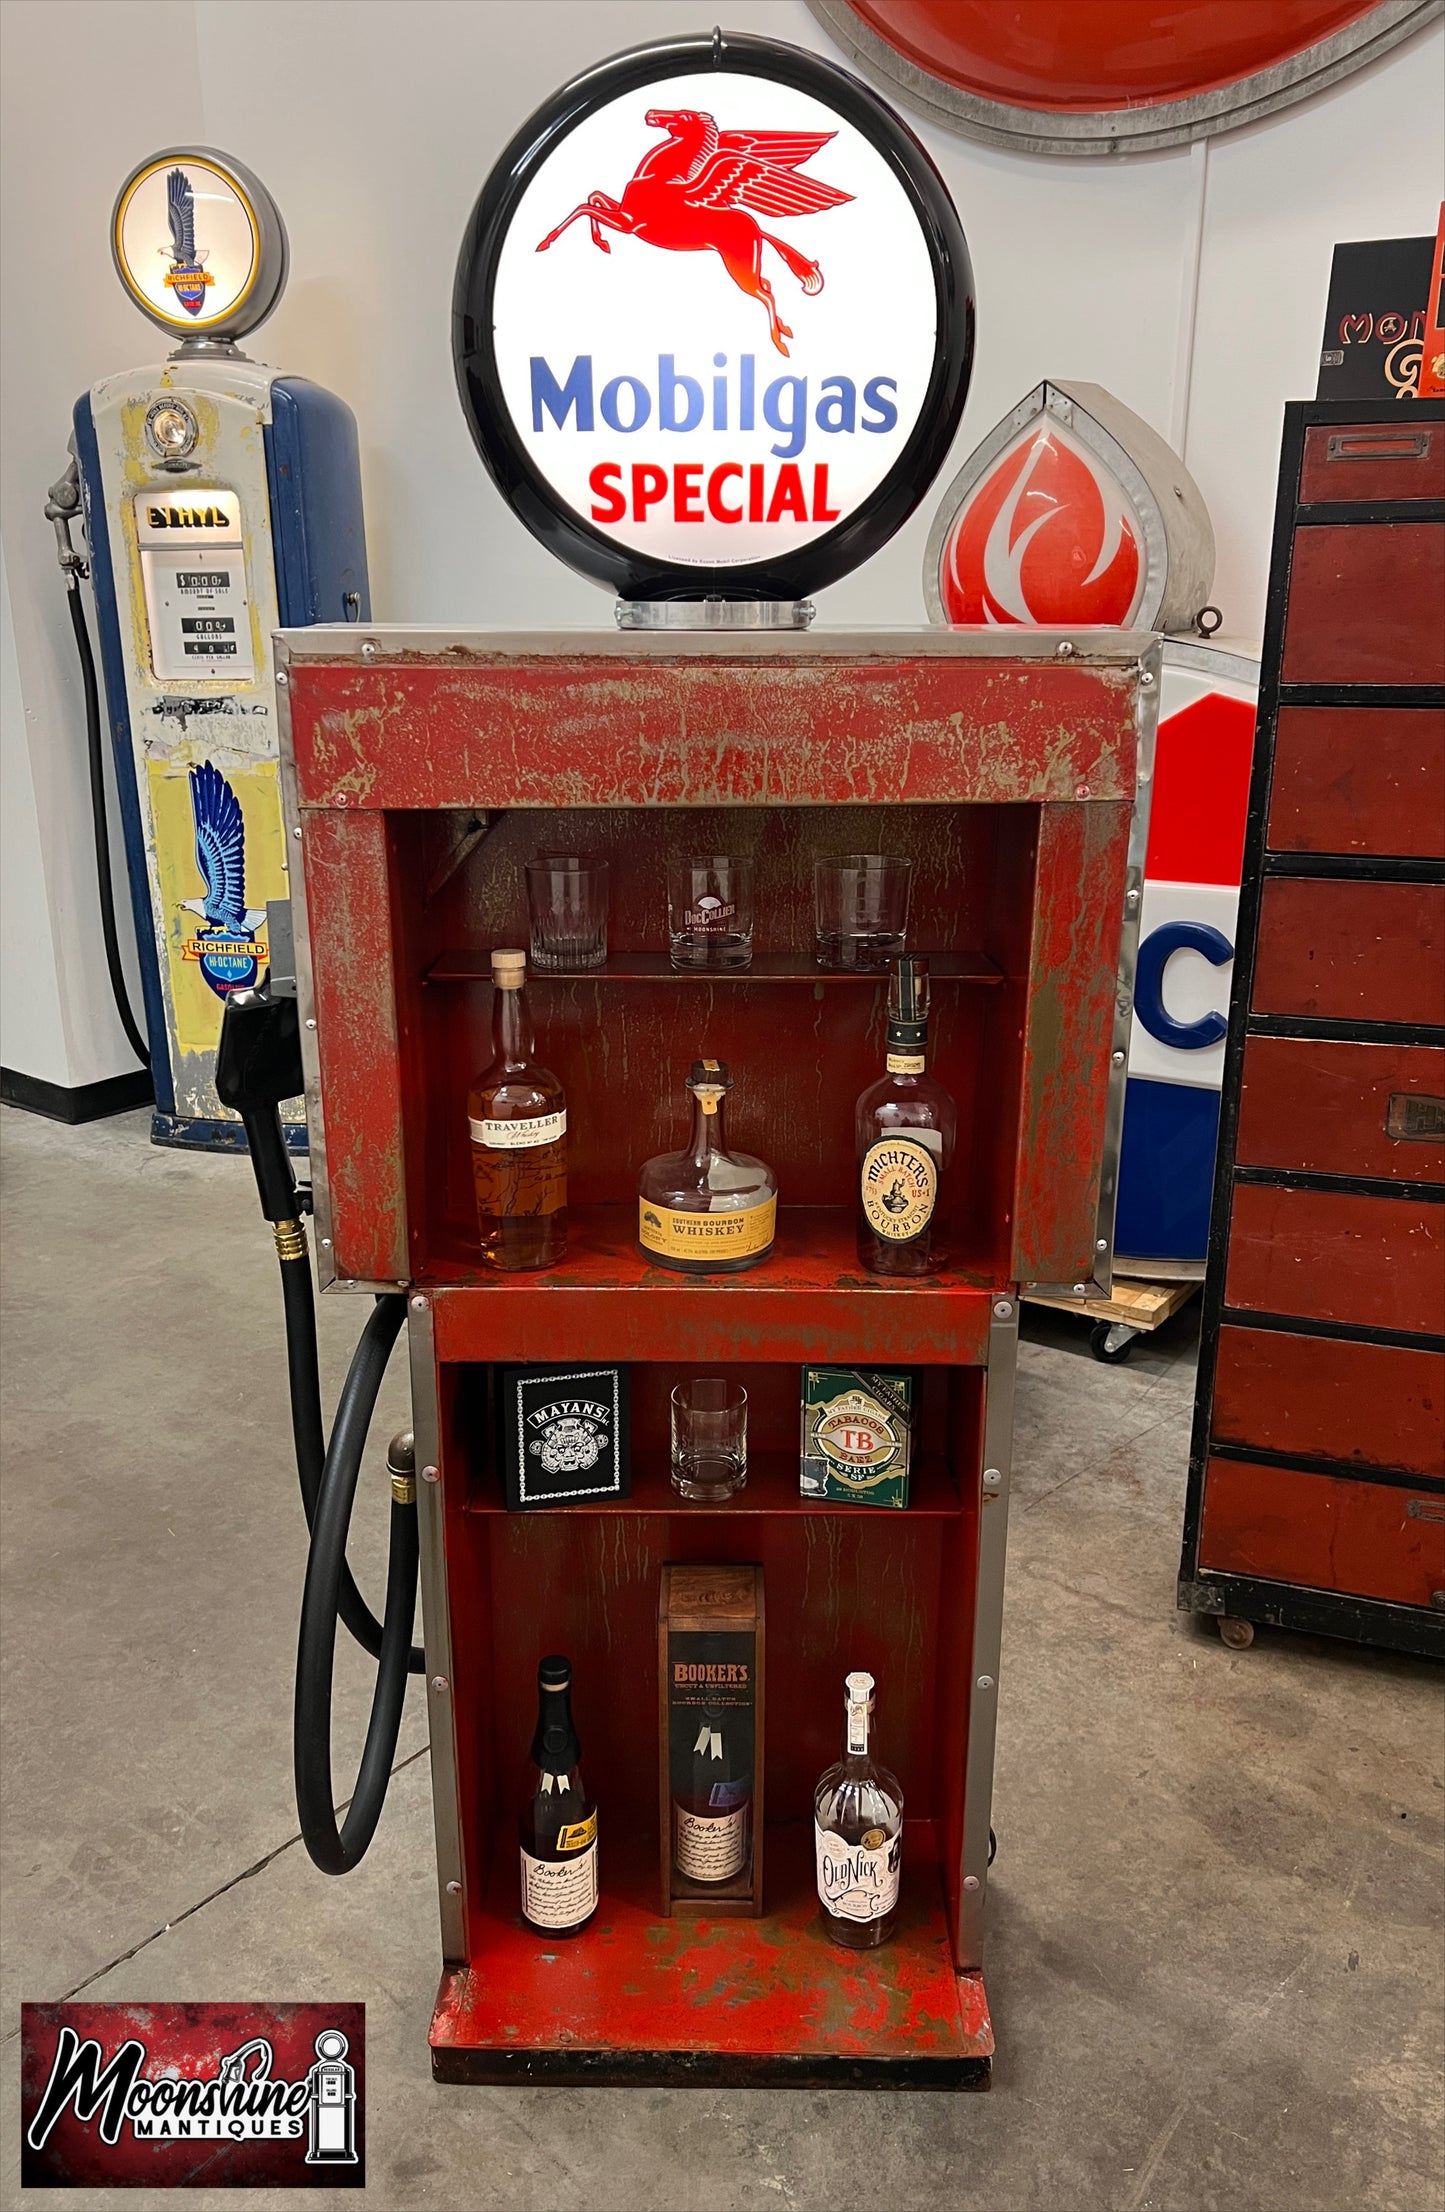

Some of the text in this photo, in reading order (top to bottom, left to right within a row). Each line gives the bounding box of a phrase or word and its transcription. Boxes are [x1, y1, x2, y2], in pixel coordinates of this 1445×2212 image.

[530, 353, 898, 458] Mobilgas
[588, 462, 842, 525] SPECIAL
[147, 506, 229, 528] ETHYL
[192, 942, 265, 954] RICHFIELD
[485, 1115, 558, 1131] TRAVELLER
[868, 1150, 929, 1188] MICHTER'S
[878, 1166, 916, 1188] SMALL BATCH
[703, 1217, 745, 1226] BOURBON
[867, 1200, 929, 1232] BOURBON
[673, 1224, 744, 1236] WHISKEY
[871, 1375, 881, 1386] MY
[871, 1386, 896, 1410] CIGARS
[534, 1402, 605, 1424] MAYANS
[827, 1415, 885, 1434] TABACOS
[840, 1429, 874, 1450] TB
[839, 1451, 873, 1464] BAEZ
[836, 1463, 876, 1474] SERIE
[674, 1663, 748, 1682] BOOKER'S
[683, 1816, 737, 1833] Booker's
[533, 1858, 587, 1878] Booker's
